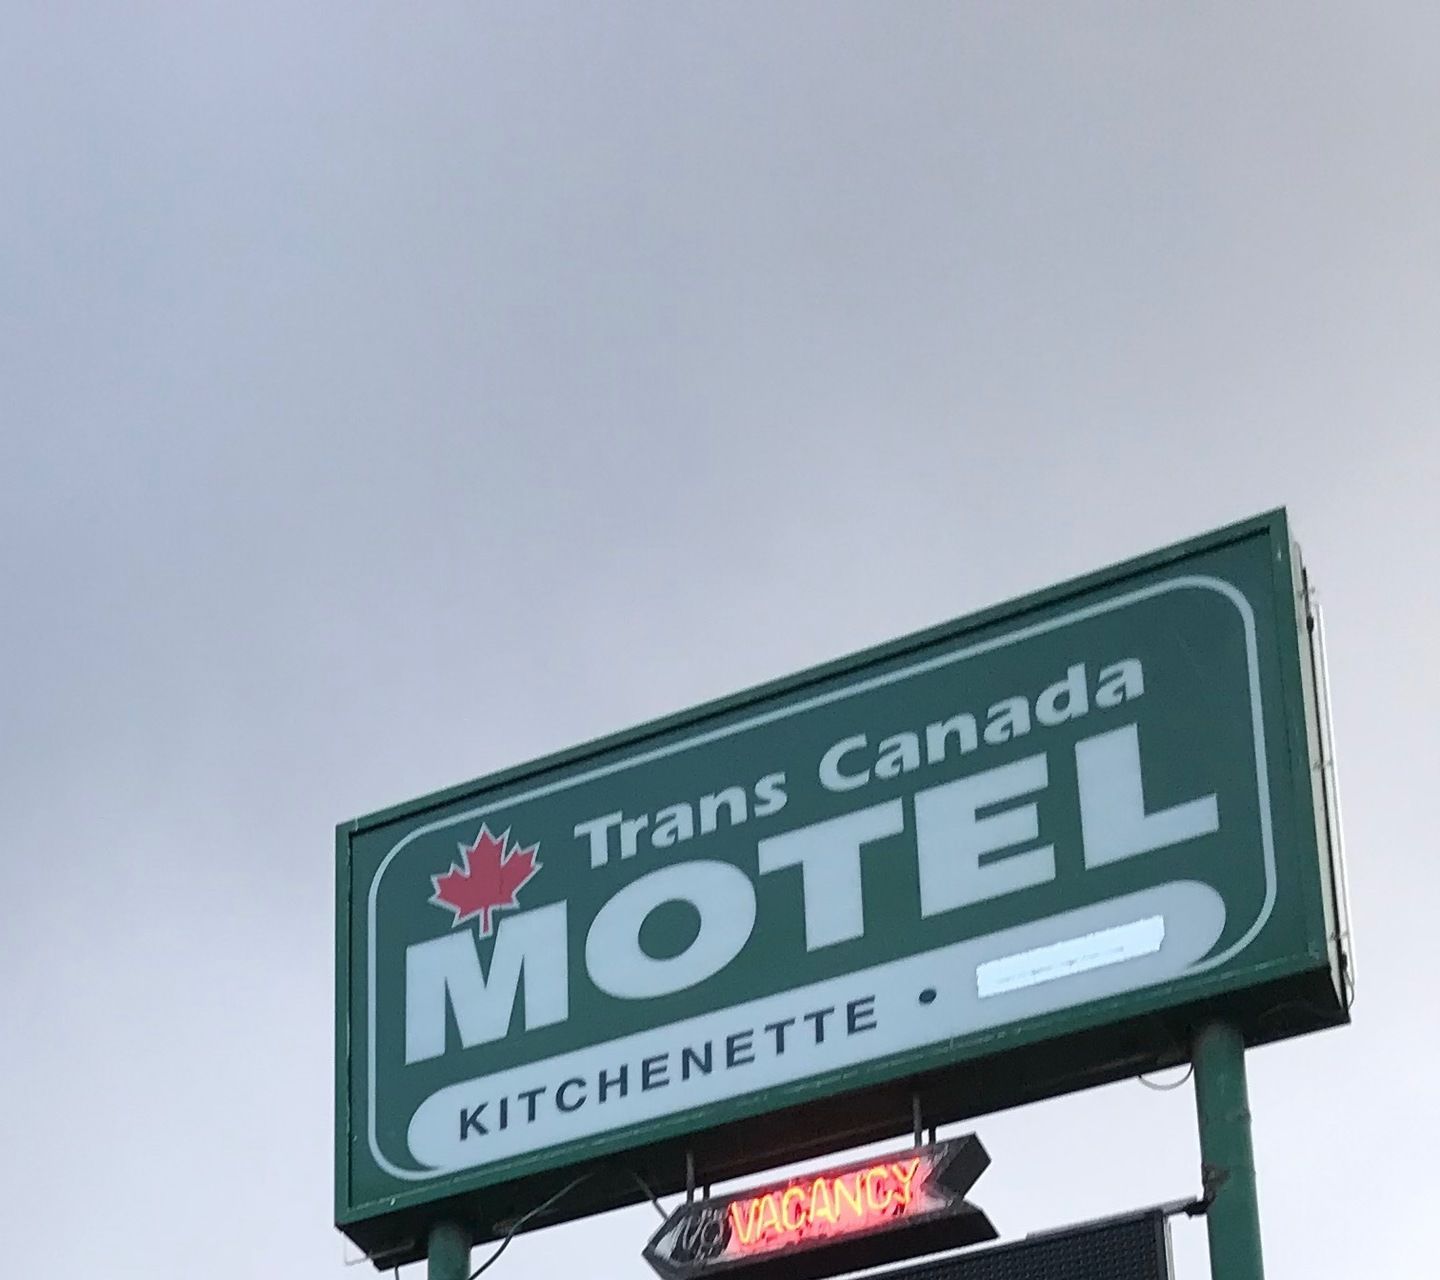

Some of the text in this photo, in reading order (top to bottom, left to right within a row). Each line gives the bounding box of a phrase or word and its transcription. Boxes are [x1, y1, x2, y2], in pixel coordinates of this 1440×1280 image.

[573, 656, 1146, 870] Trans Canada
[404, 722, 1220, 1065] MOTEL
[459, 995, 878, 1141] KITCHENETTE
[730, 1156, 921, 1245] VACANCY
